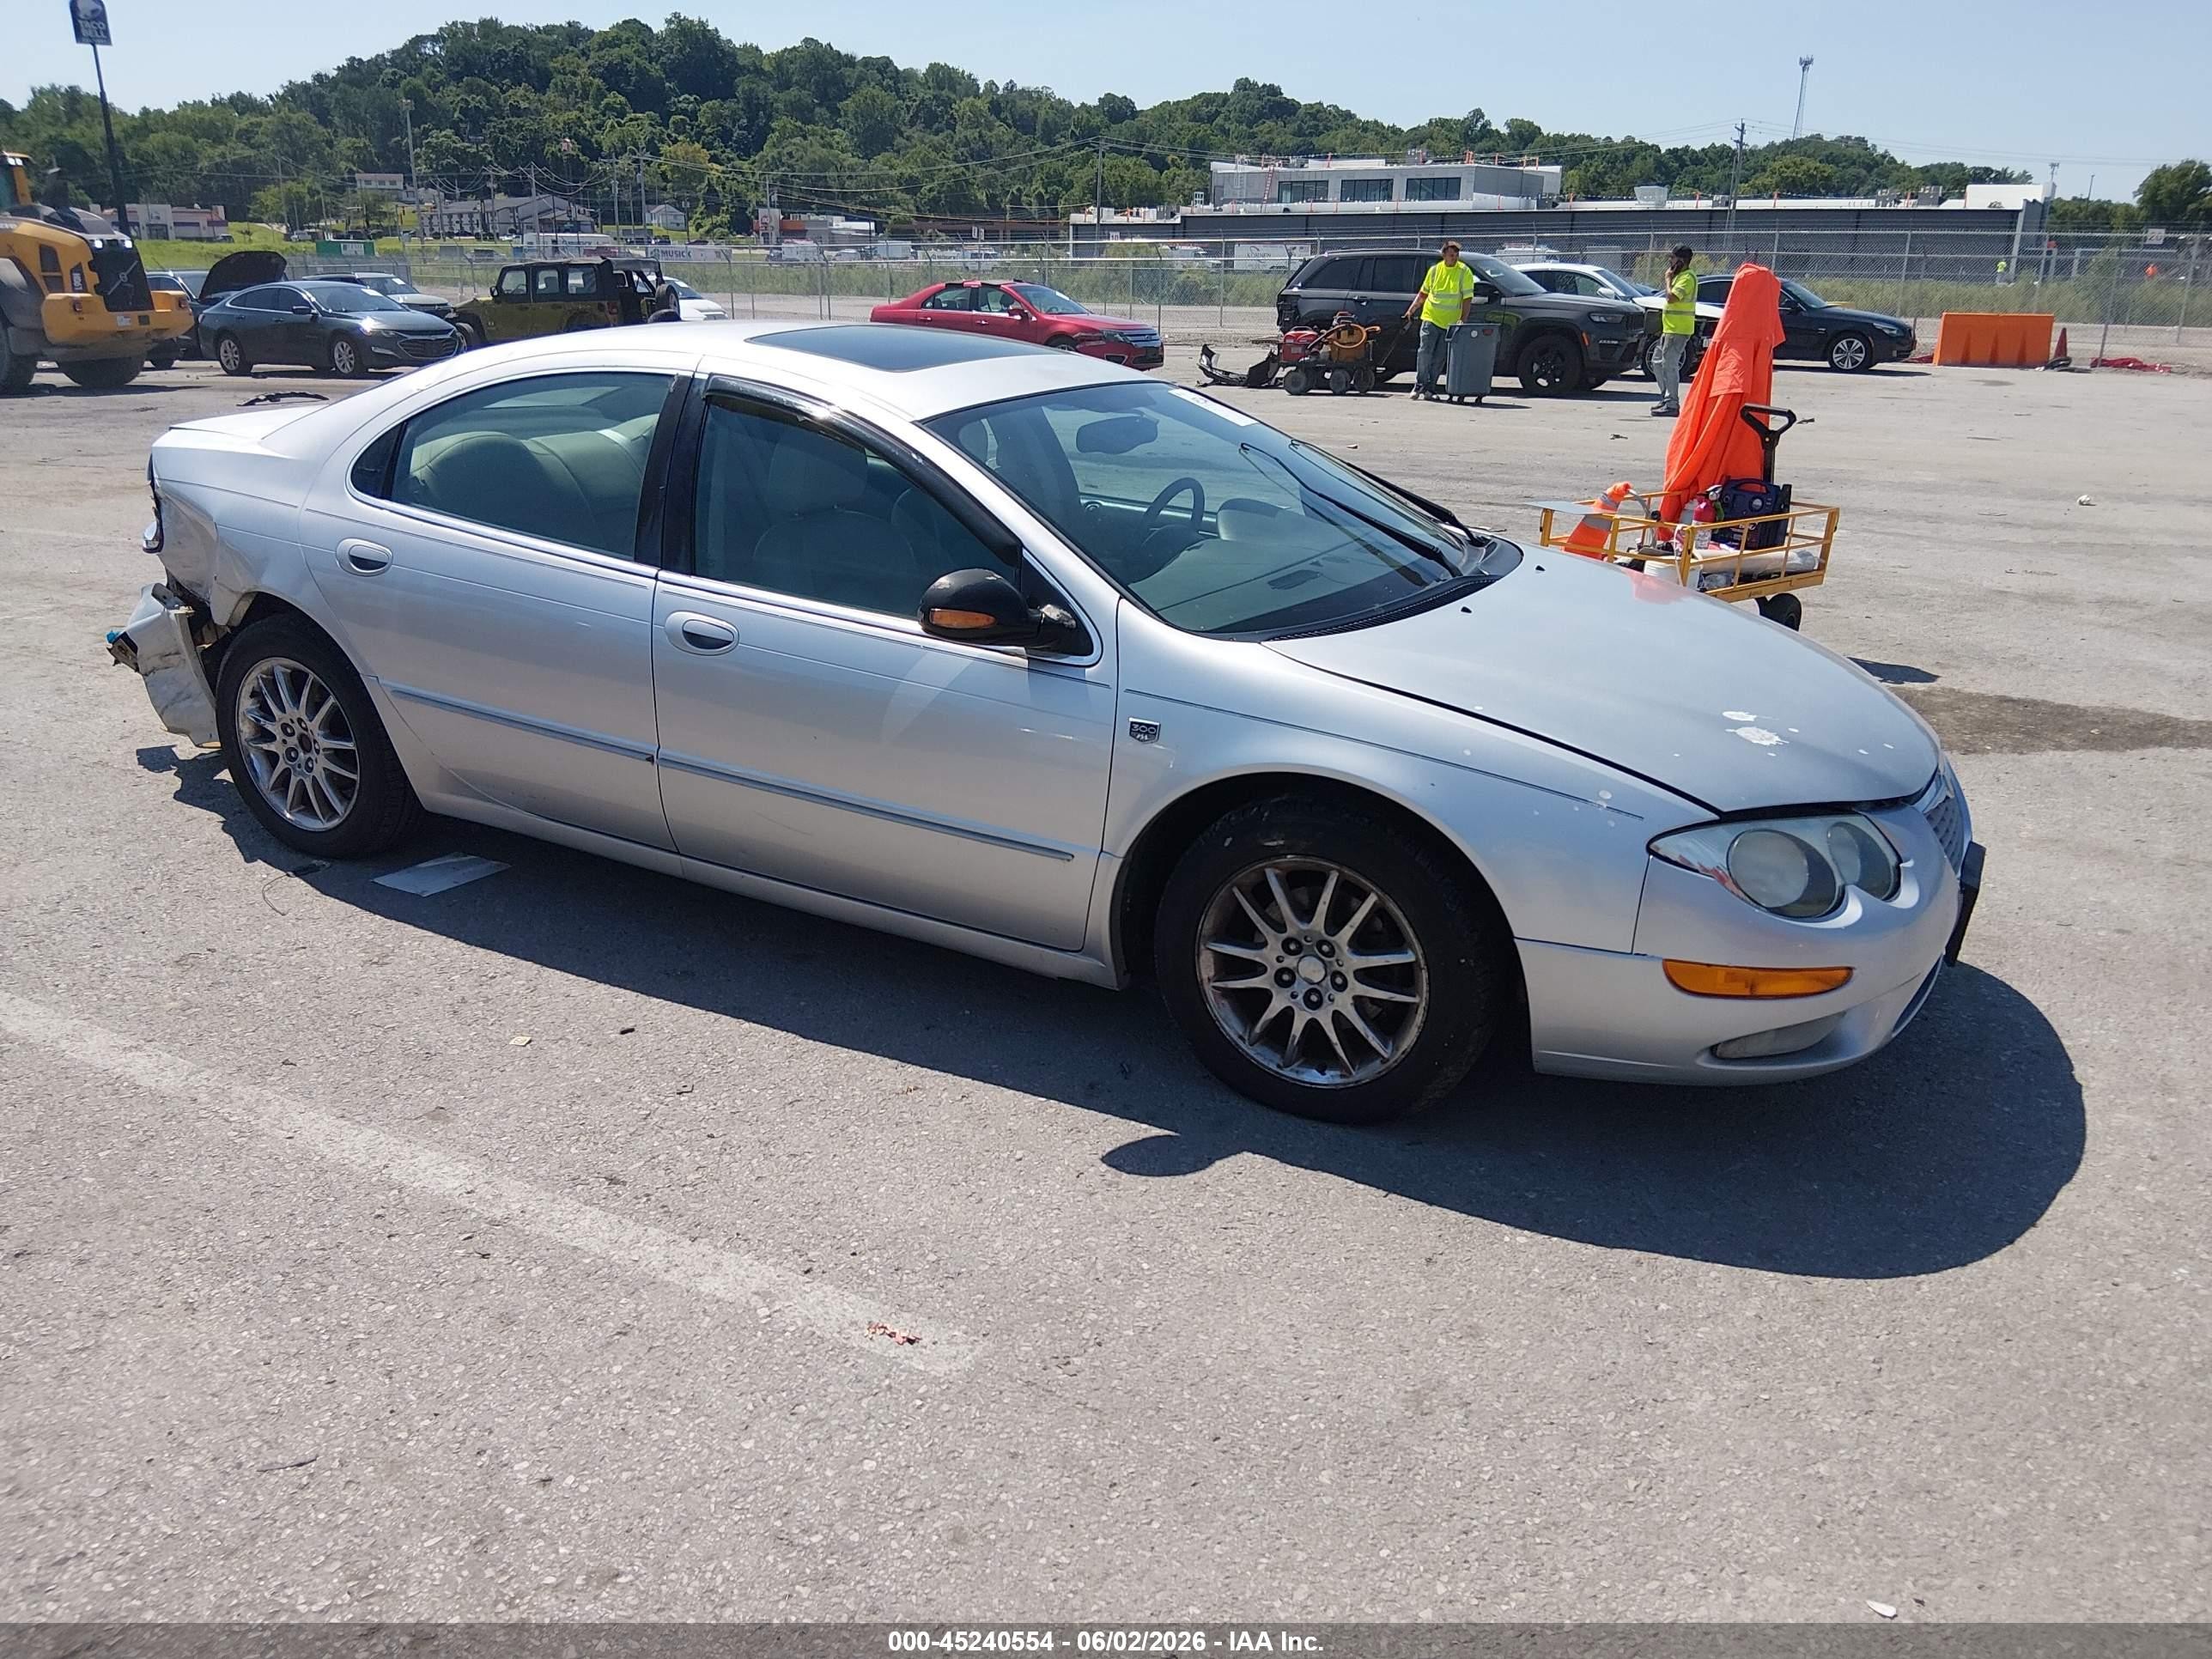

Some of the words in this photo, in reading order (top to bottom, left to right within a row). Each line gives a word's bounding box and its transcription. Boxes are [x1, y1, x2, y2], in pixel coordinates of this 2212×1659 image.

[78, 20, 105, 28] TACO
[81, 27, 107, 39] BELL
[1131, 724, 1156, 734] 300
